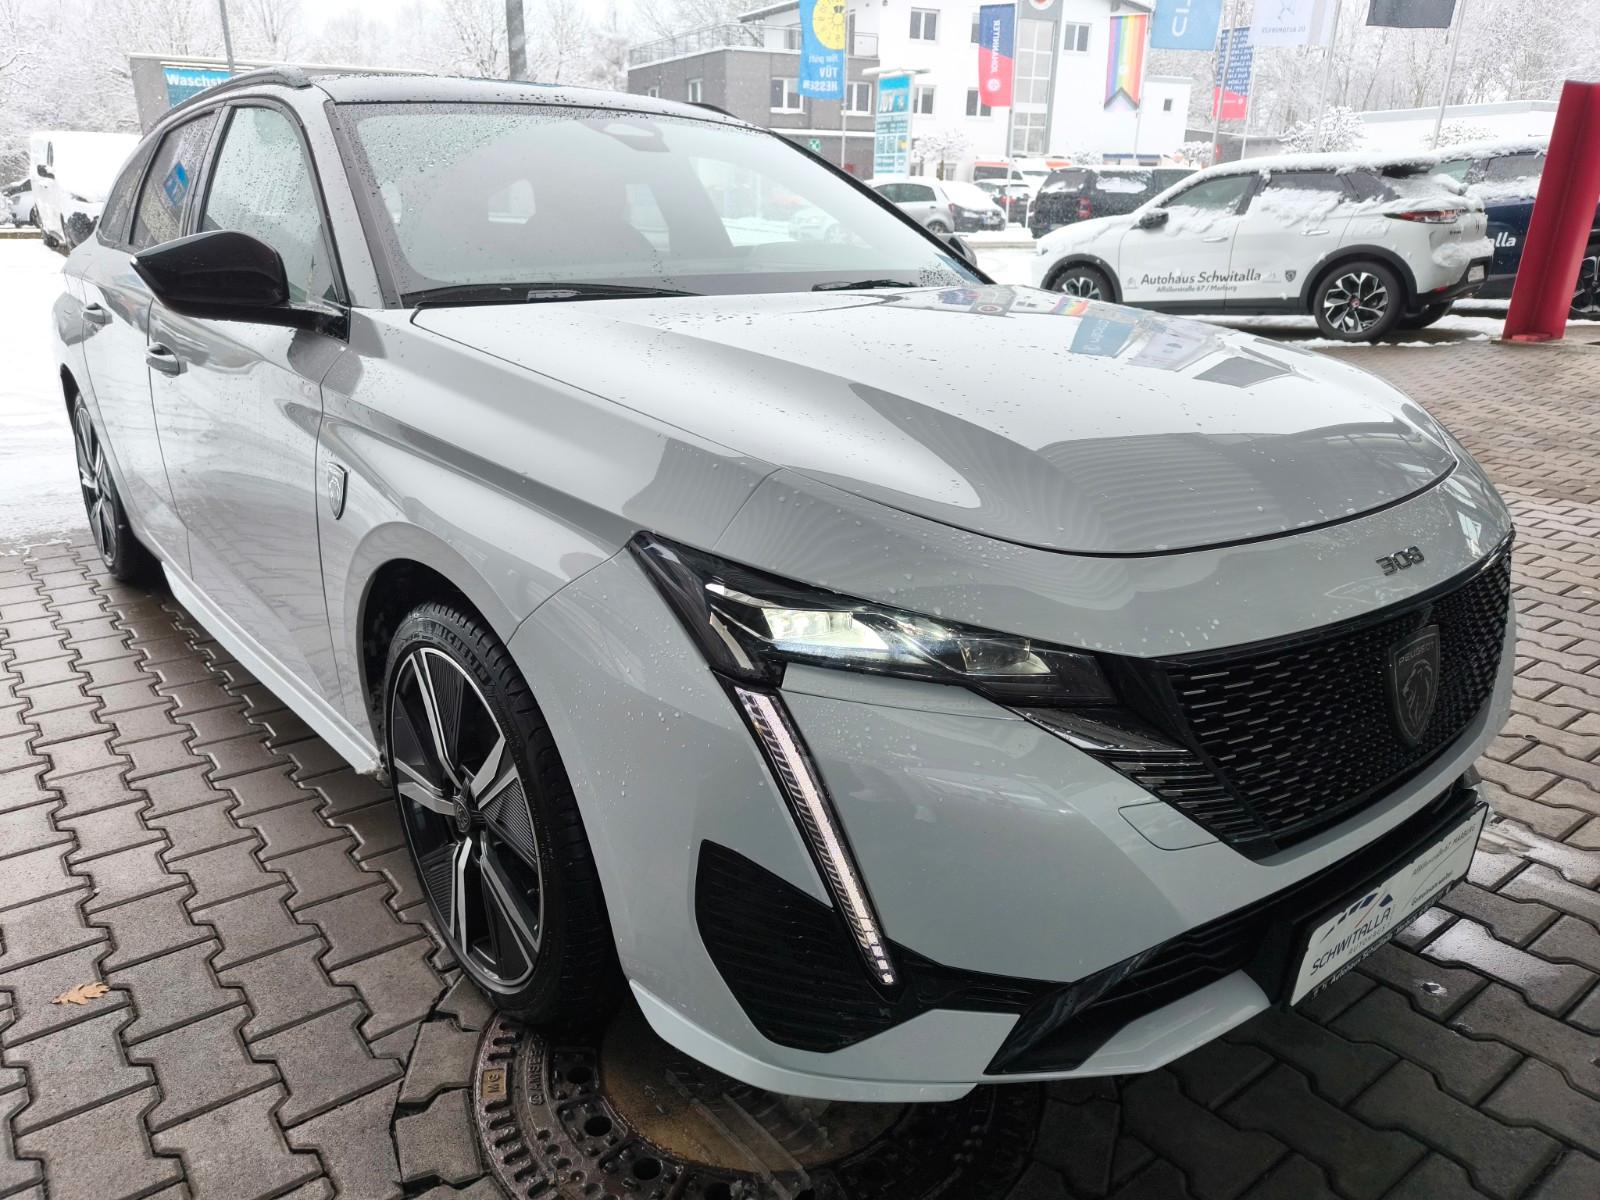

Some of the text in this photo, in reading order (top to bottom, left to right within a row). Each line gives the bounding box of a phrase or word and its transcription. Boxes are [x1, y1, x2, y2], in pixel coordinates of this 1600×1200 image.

[1140, 268, 1262, 286] Autohaus Schwitalla
[1375, 546, 1425, 577] 308
[434, 622, 492, 686] MICHELIN
[1398, 641, 1434, 666] PEUGEOT
[1310, 907, 1391, 977] SCHWITALLA
